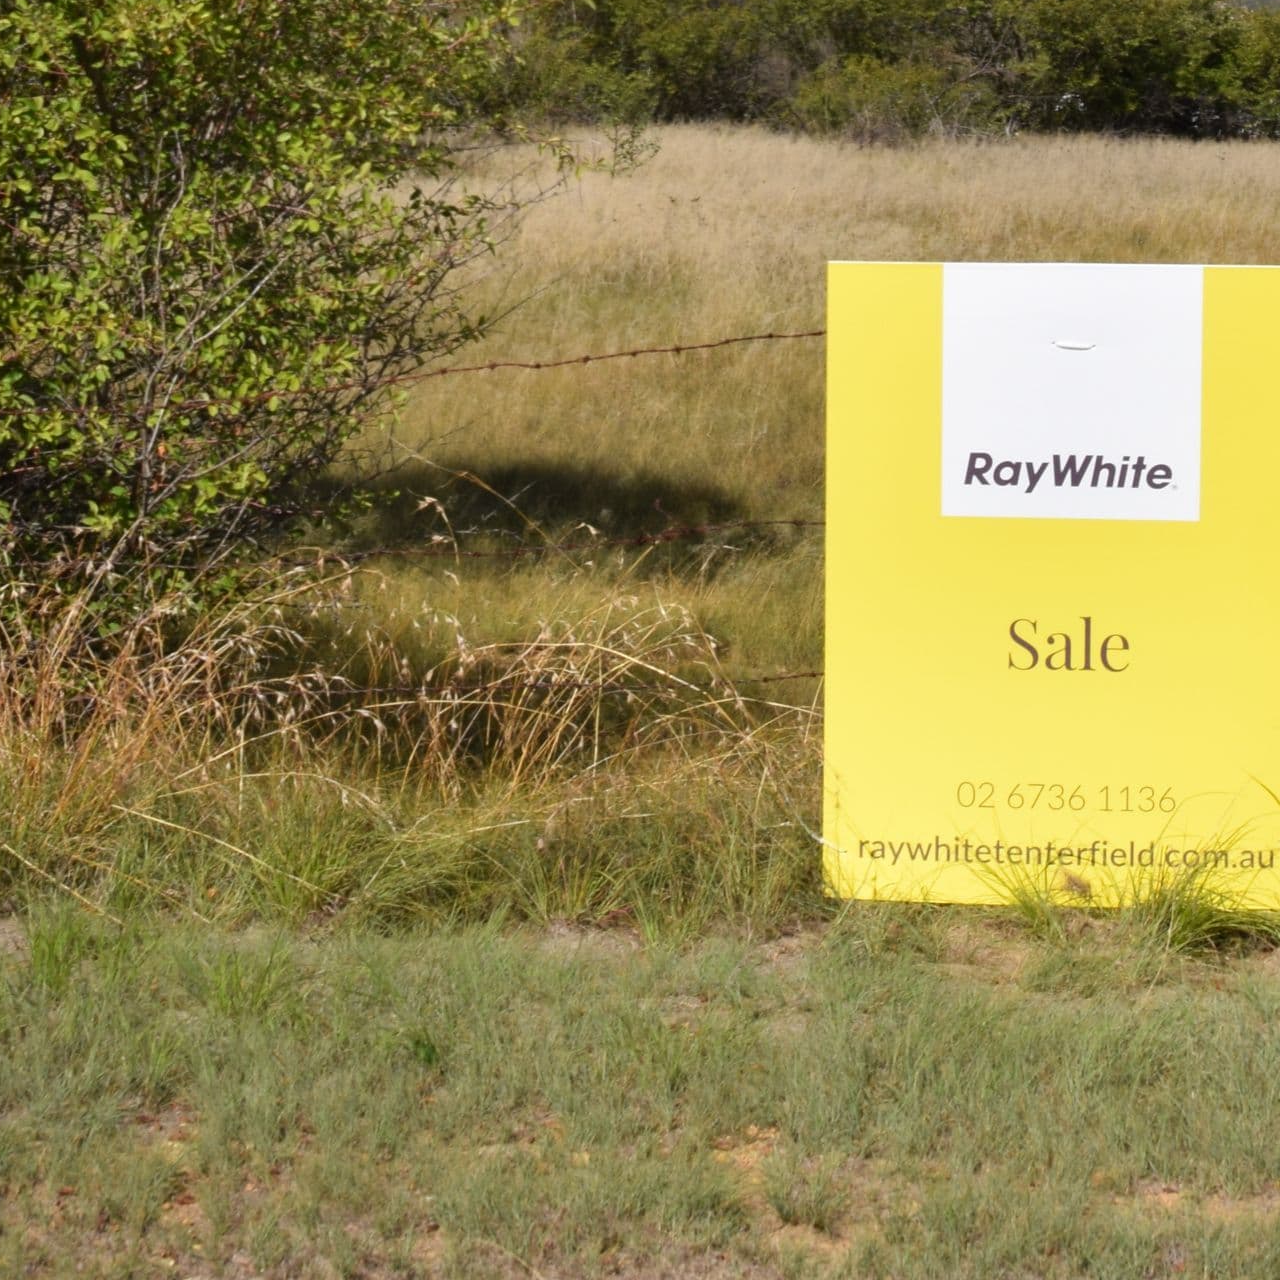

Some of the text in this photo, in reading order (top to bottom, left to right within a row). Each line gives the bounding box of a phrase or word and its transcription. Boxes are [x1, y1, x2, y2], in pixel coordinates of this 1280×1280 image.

[1008, 616, 1130, 672] Sale
[956, 781, 1177, 813] 02 6736 1136
[857, 835, 1275, 870] raywhitetenterfield.com.au
